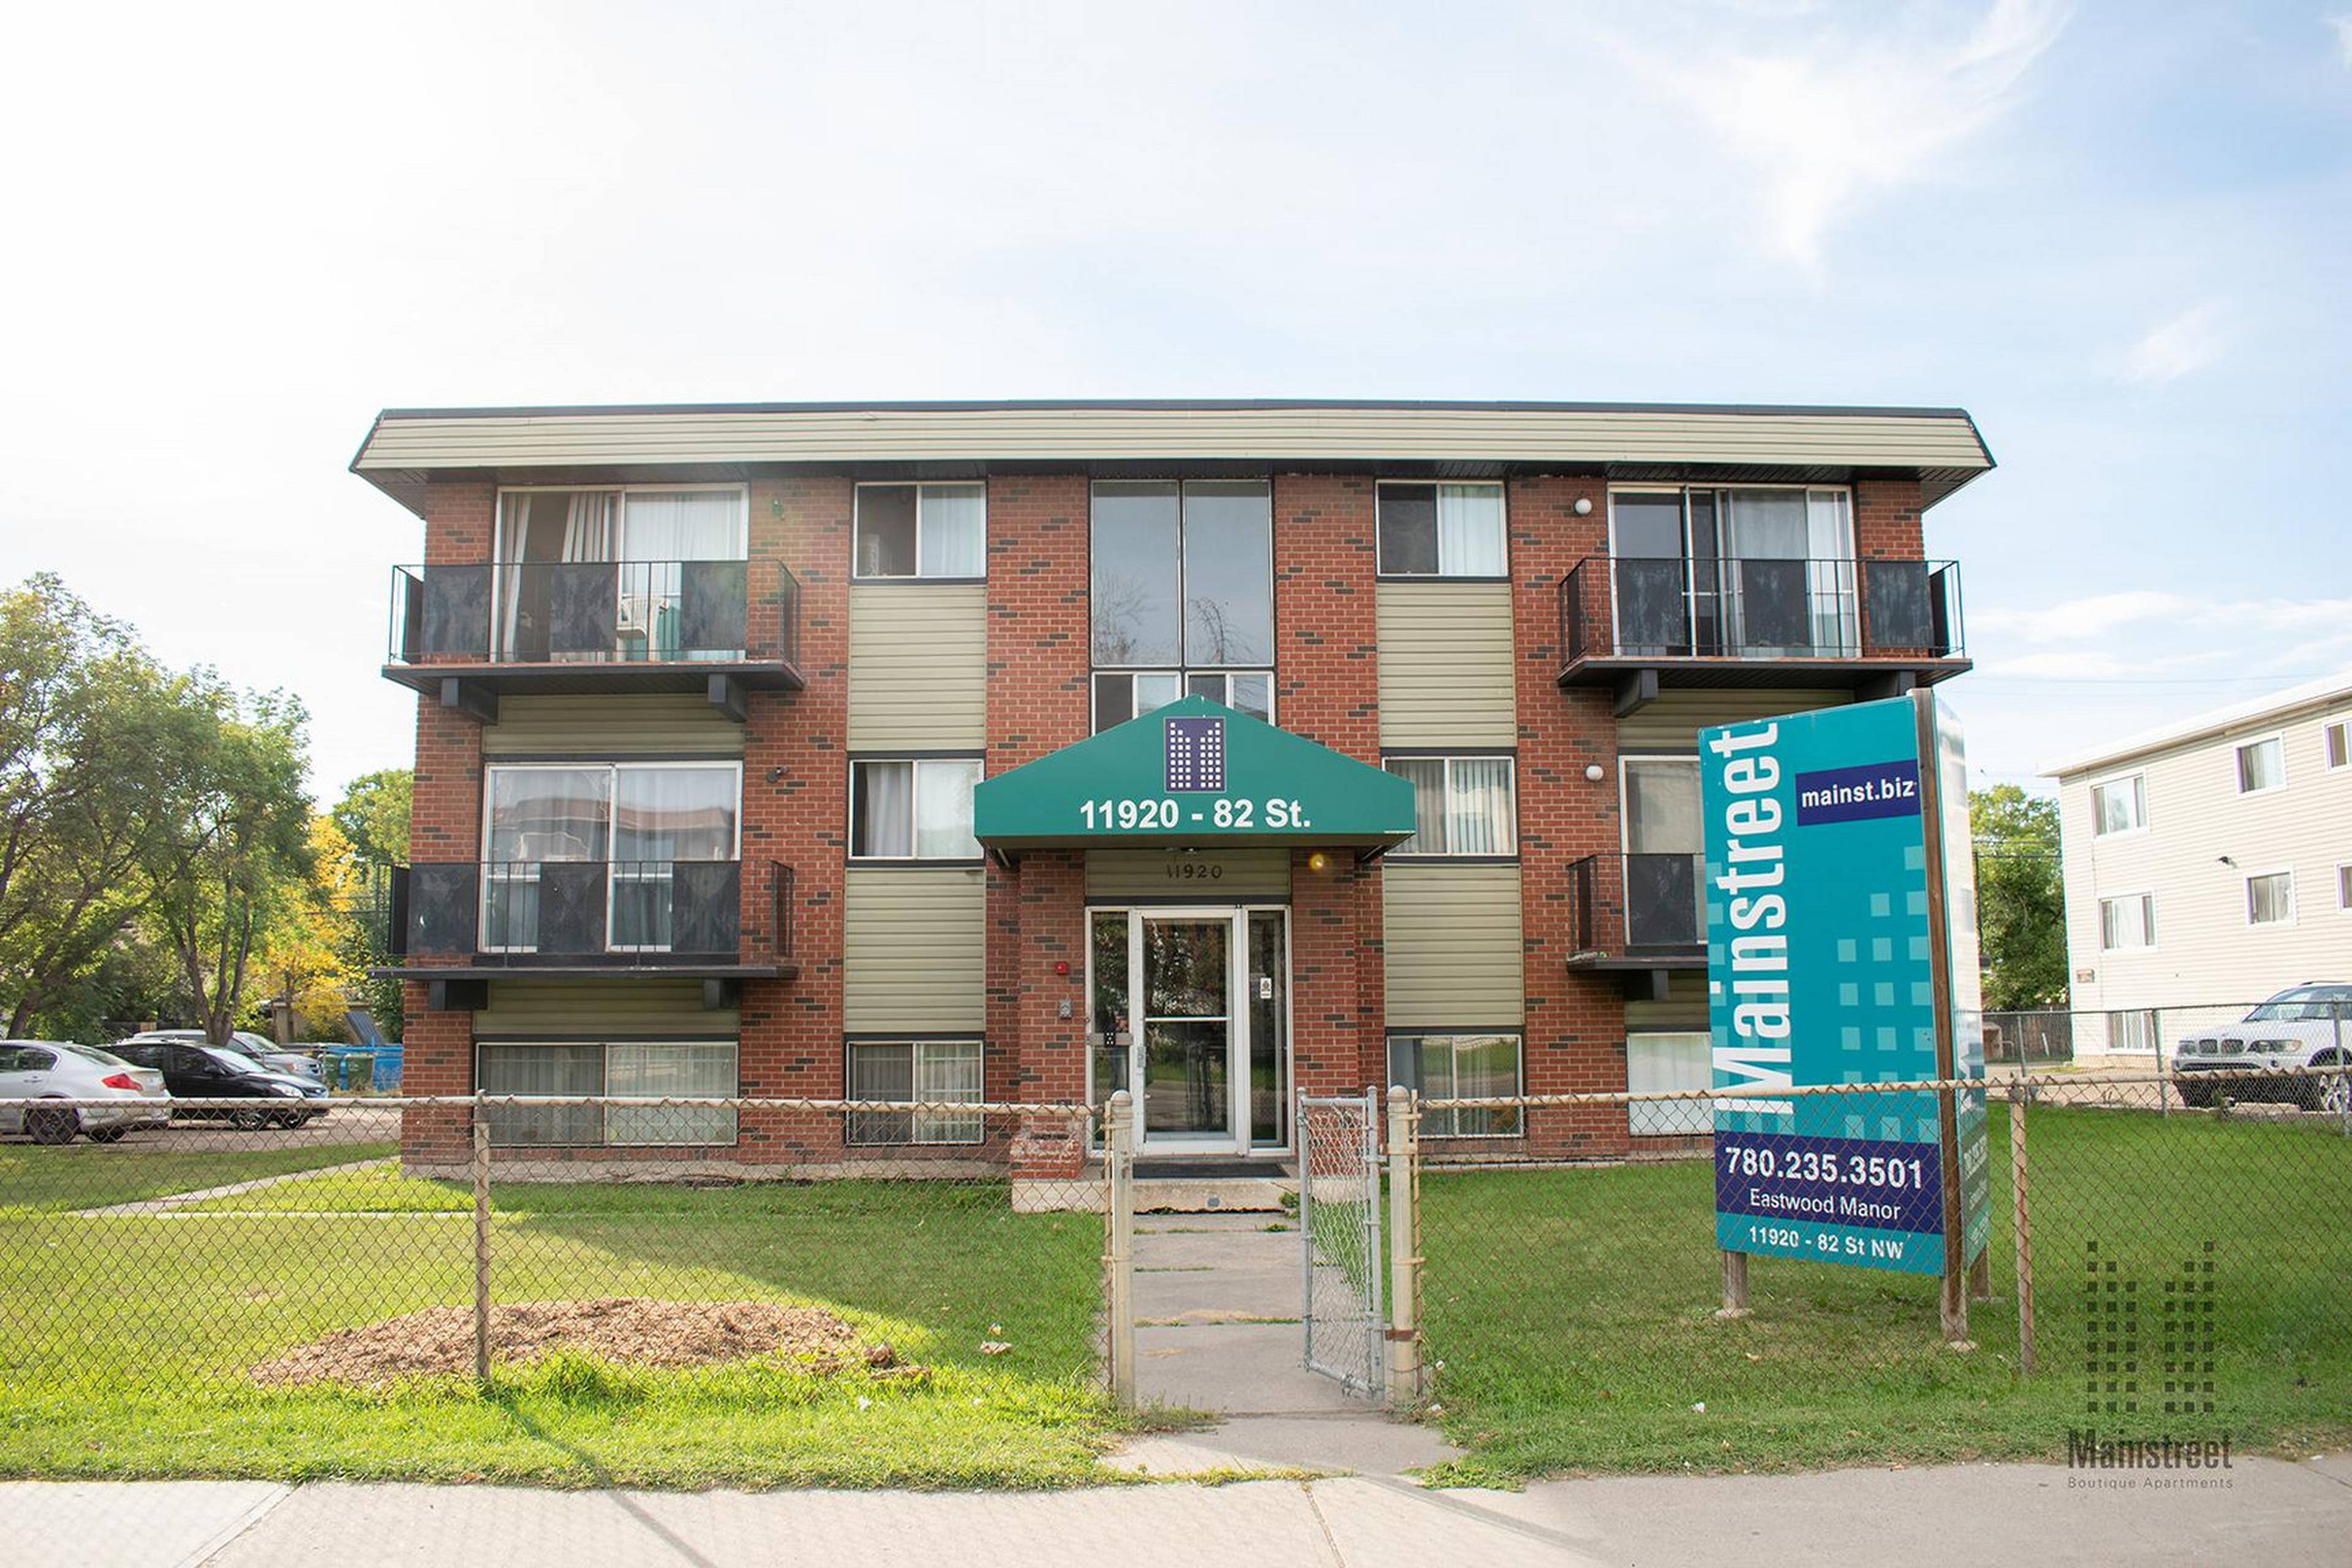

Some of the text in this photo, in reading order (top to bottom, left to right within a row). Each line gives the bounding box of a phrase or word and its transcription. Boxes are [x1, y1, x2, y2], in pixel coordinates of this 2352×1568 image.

[1801, 777, 1915, 808] mainst.biz
[1080, 799, 1311, 829] 11920 - 82 St.
[1166, 863, 1223, 879] 11920
[1709, 723, 1793, 1114] Mainstreet
[1725, 1147, 1922, 1189] 780.235.3501
[1749, 1188, 1901, 1220] Eastwood Manor
[1749, 1226, 1800, 1248] 11920
[1817, 1234, 1839, 1253] 82
[1845, 1235, 1865, 1256] St
[1871, 1238, 1904, 1260] NW
